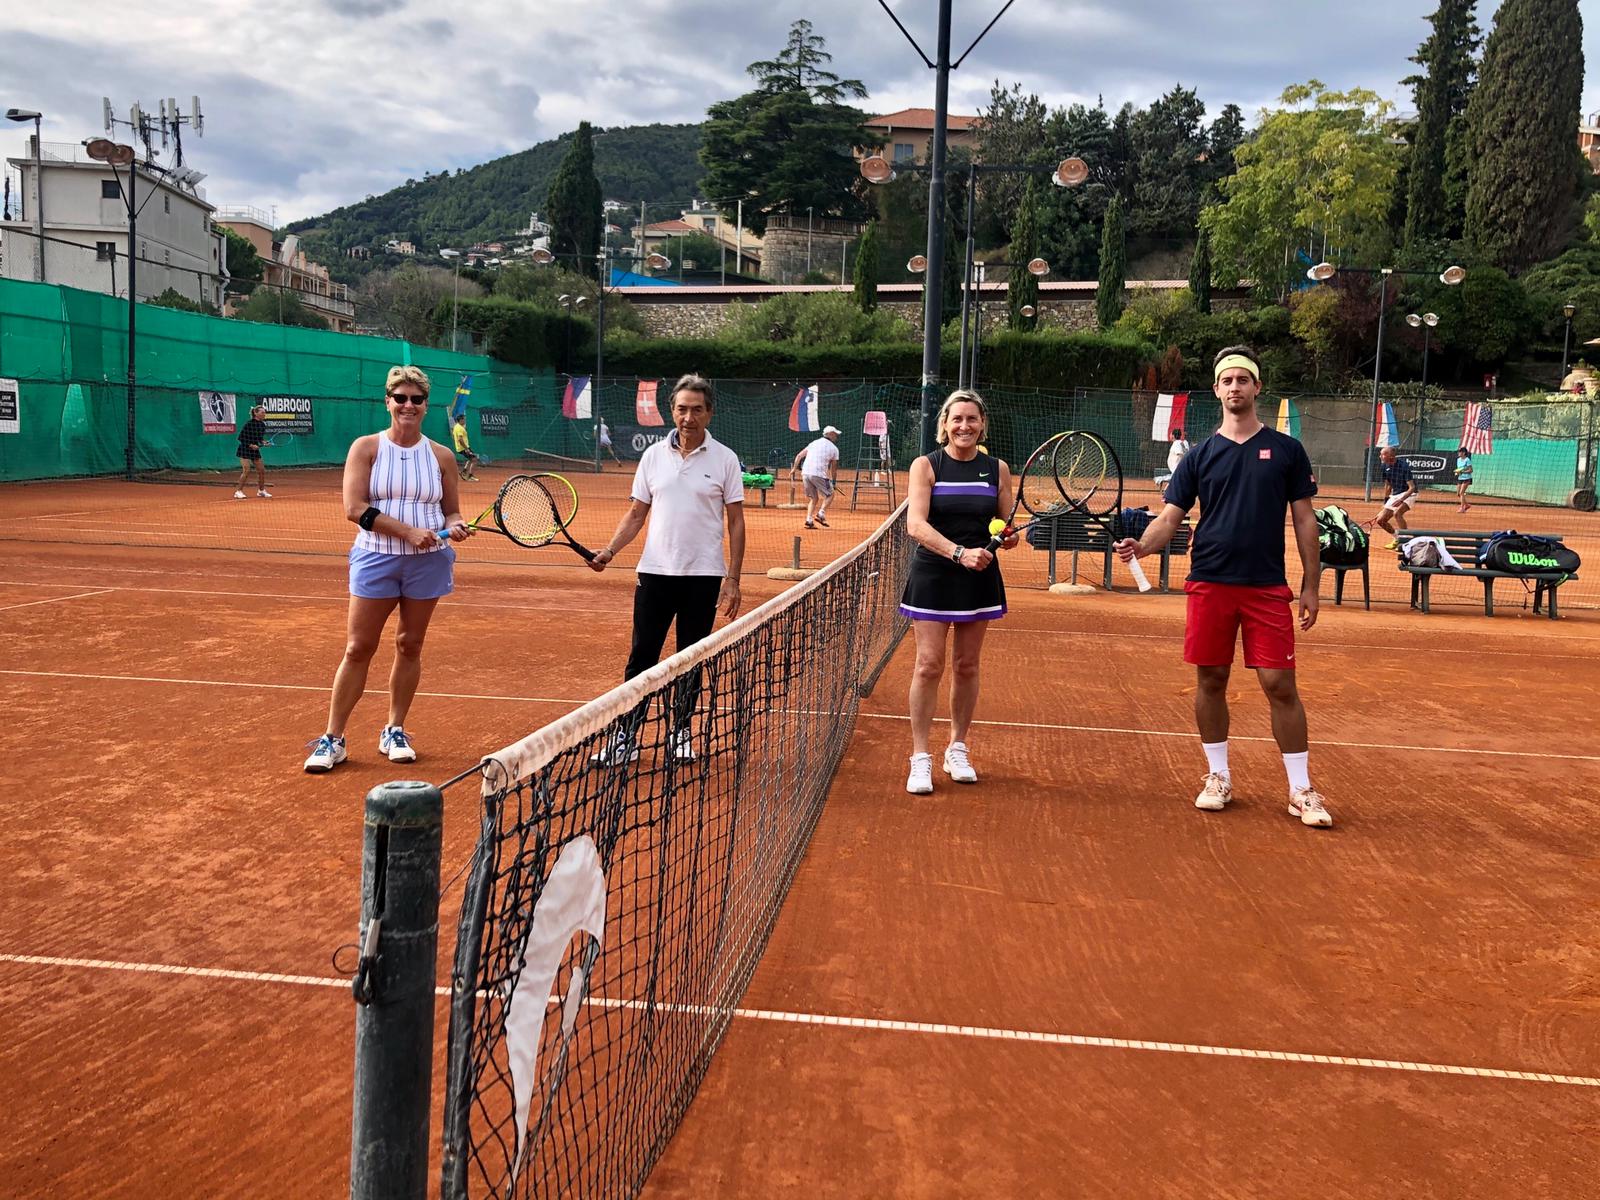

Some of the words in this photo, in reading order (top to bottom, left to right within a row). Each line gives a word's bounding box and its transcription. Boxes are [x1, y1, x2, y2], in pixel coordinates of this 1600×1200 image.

[262, 397, 311, 412] AMBROGIO
[481, 414, 509, 426] ALASSIO
[1406, 458, 1441, 468] berasco
[1507, 551, 1560, 567] Wilson
